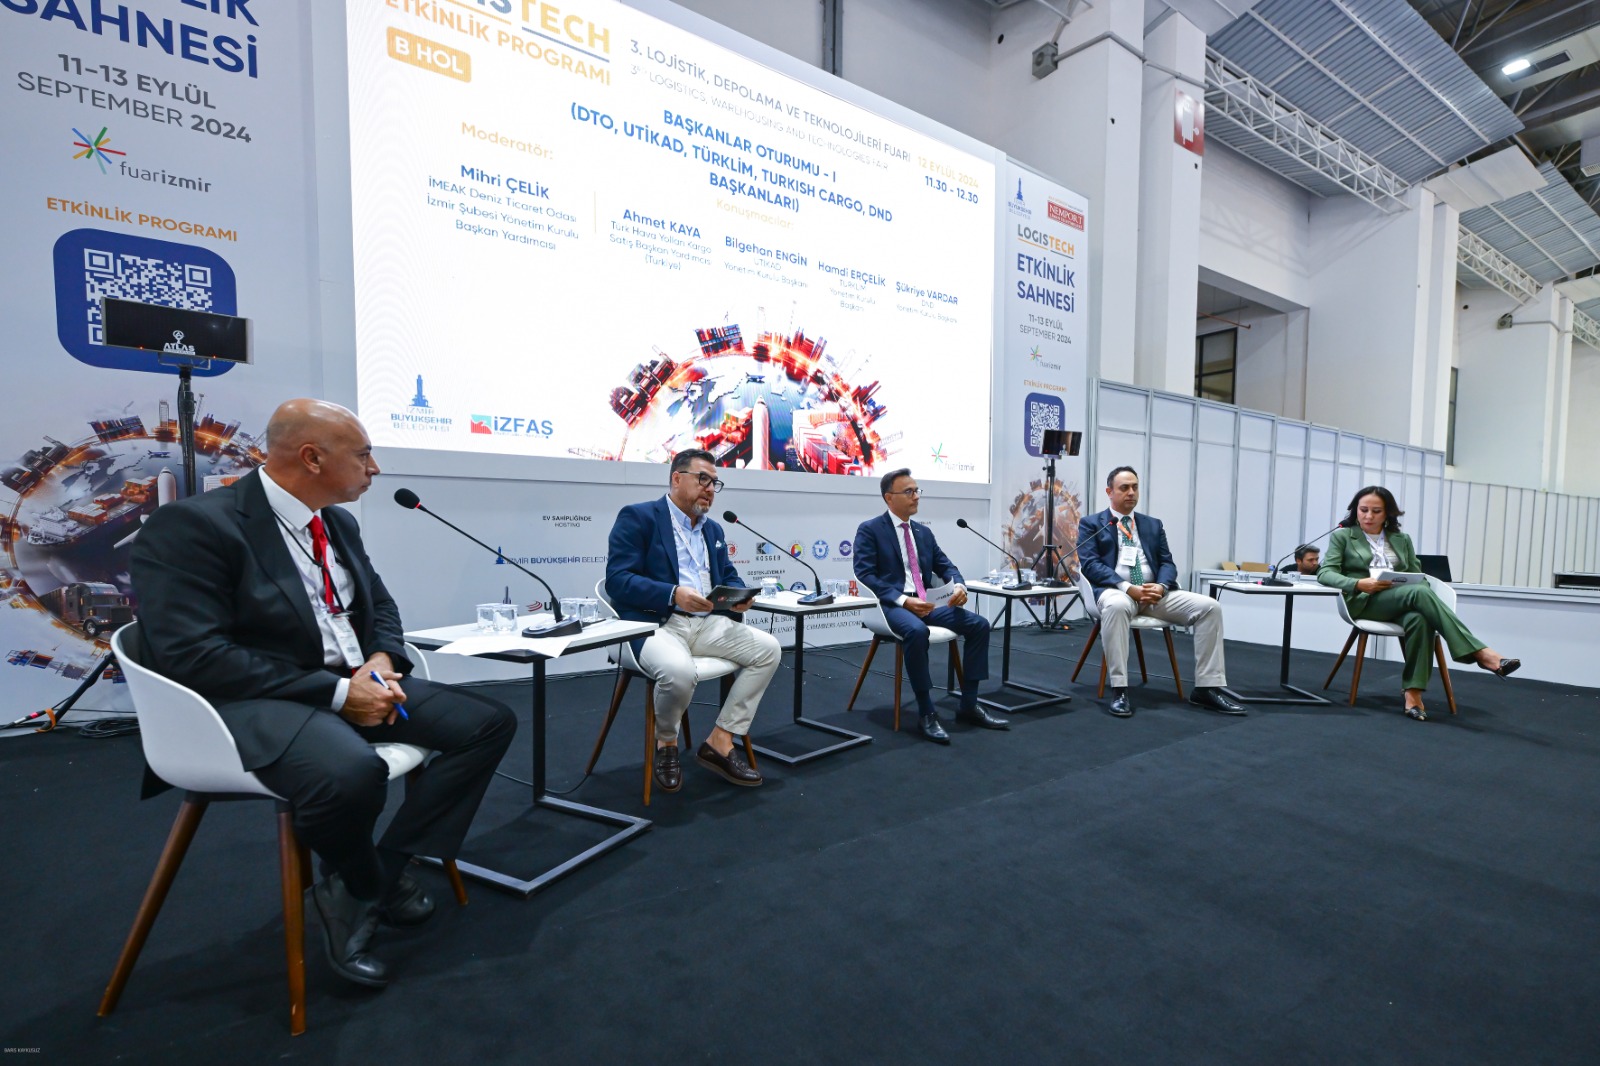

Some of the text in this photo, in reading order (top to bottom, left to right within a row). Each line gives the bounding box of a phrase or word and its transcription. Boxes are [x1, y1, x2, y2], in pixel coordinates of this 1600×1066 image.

[395, 34, 464, 74] B HOL
[497, 30, 611, 86] PROGRAMI
[58, 53, 216, 109] 11-13 EYLÜL
[17, 71, 251, 143] SEPTEMBER 2024
[630, 39, 643, 56] 3.
[647, 46, 710, 85] LOJİSTİK,
[714, 74, 783, 112] DEPOLAMA
[786, 103, 800, 119] VE
[803, 110, 882, 151] TEKNOLOJİLERİ
[884, 144, 911, 163] FUARI
[461, 121, 554, 160] Moderatör:
[663, 110, 752, 153] BAŞKANLAR
[755, 144, 820, 177] OTURUMU
[786, 125, 806, 140] AND
[119, 161, 212, 192] fuarizmir
[571, 102, 893, 223] (DTO, UTİKAD, TÜRKLİM, TURKISH CARGO, DND
[461, 164, 550, 201] Mihri ÇELİK
[709, 172, 800, 214] BAŞKANLARI)
[925, 175, 948, 193] 11.30
[956, 187, 979, 205] 12.30
[958, 173, 979, 189] 2024
[428, 175, 577, 223] İMEAK Deniz Ticaret Odası
[1049, 204, 1083, 225] NEMPORT
[47, 197, 238, 242] ETKİNLİK PROGRAMI
[427, 193, 580, 240] İzmir Şubesi Yönetim Kurulu
[455, 219, 499, 238] Başkan
[623, 209, 701, 239] Ahmet KAYA
[632, 226, 657, 240] Hava
[635, 239, 669, 255] Başkan
[1017, 224, 1075, 256] LOGISTECH
[725, 235, 808, 267] Bilgehan ENGİN
[818, 261, 886, 287] Hamdi ERÇELİK
[1017, 253, 1075, 288] ETKİNLİK
[895, 281, 959, 306] Şükriye VARDAR
[1017, 280, 1075, 313] SAHNESİ
[1019, 324, 1072, 345] SEPTEMBER 2024
[1028, 313, 1045, 326] 11-13
[163, 342, 195, 352] ATLAS
